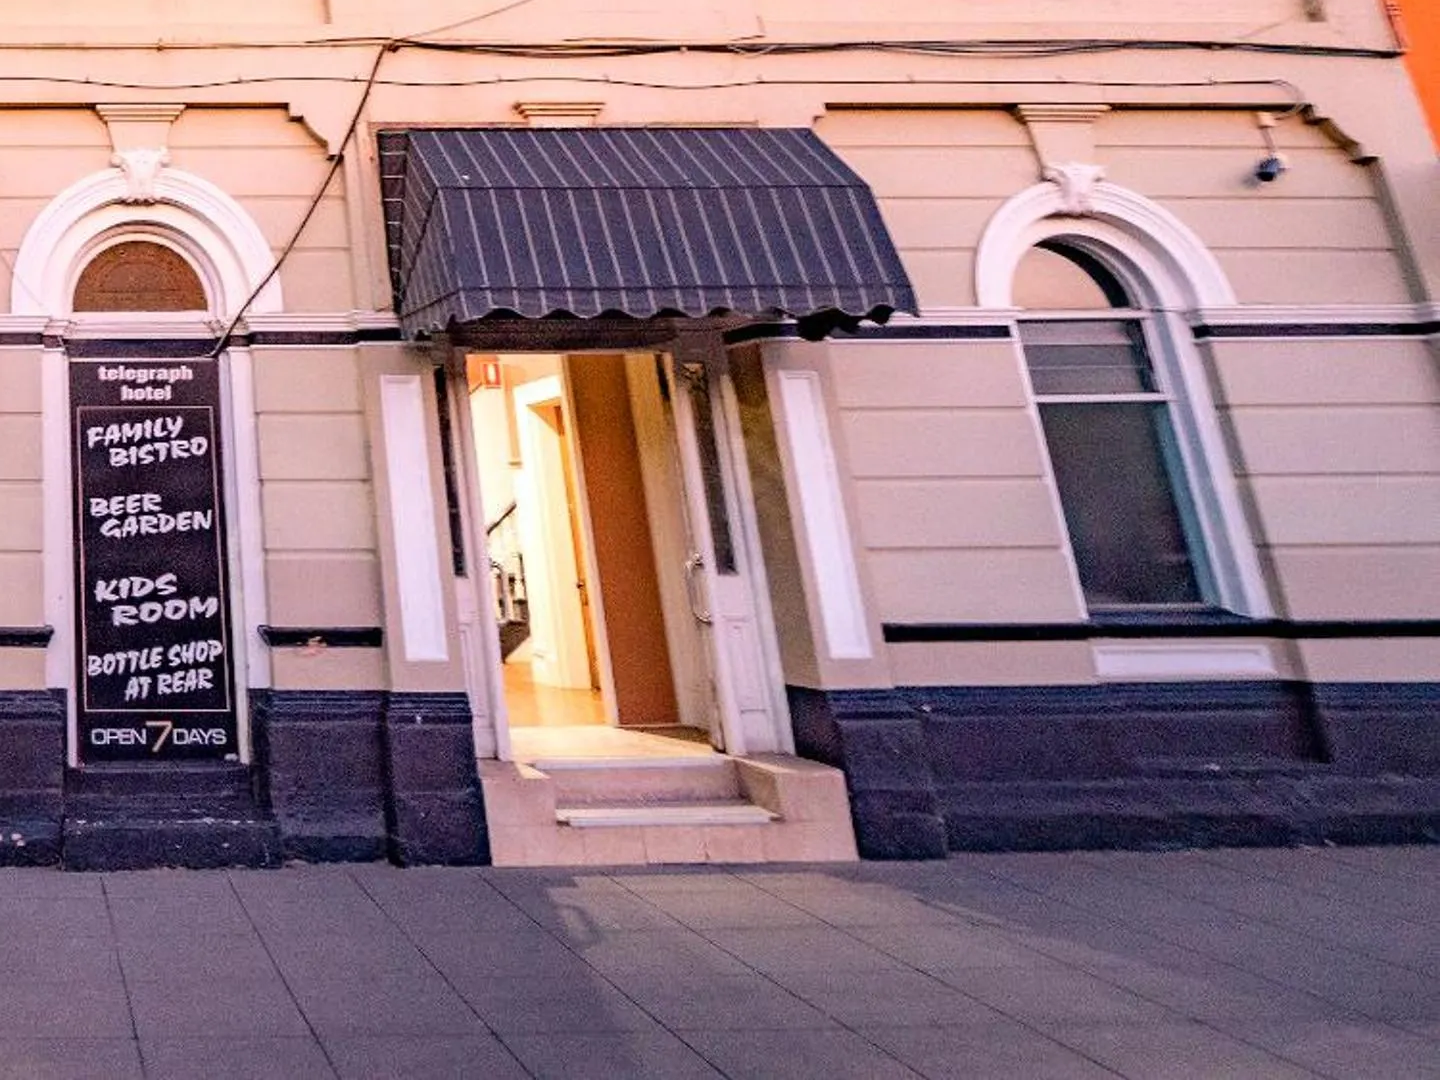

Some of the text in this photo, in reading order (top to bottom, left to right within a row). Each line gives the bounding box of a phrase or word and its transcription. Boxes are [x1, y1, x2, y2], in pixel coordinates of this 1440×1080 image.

[97, 365, 194, 383] telegraph
[119, 384, 173, 401] hotel
[87, 416, 184, 449] FAMILY
[109, 436, 208, 467] BISTRO
[89, 493, 163, 517] BEER
[99, 509, 213, 539] GARDEN
[93, 573, 178, 603] KIDS
[111, 596, 219, 626] ROOM
[87, 640, 224, 676] BOTTLE SHOP
[124, 668, 214, 702] AT REAR
[91, 720, 228, 753] OPEN 7 DAYS
